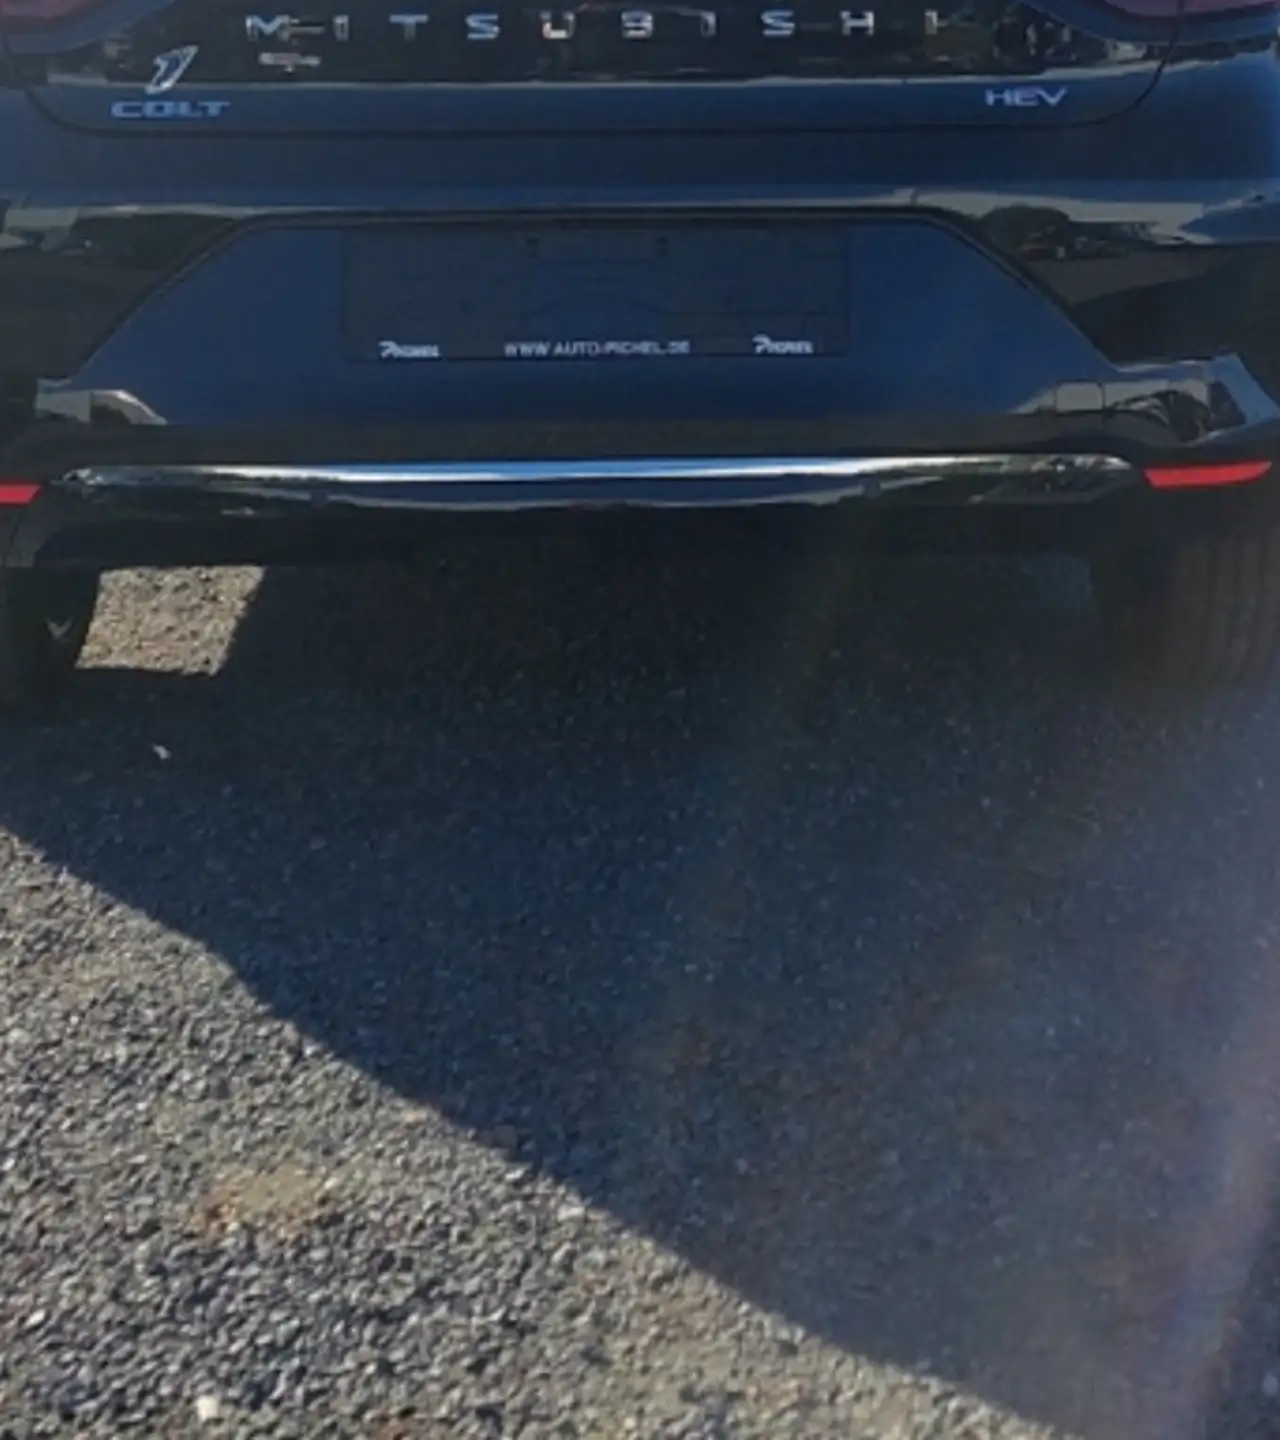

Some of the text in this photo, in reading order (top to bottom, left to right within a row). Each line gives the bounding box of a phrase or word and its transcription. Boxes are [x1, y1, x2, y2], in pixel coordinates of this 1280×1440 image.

[245, 10, 939, 41] MITSUBISHI
[984, 86, 1067, 107] HEV
[110, 100, 231, 119] COLT
